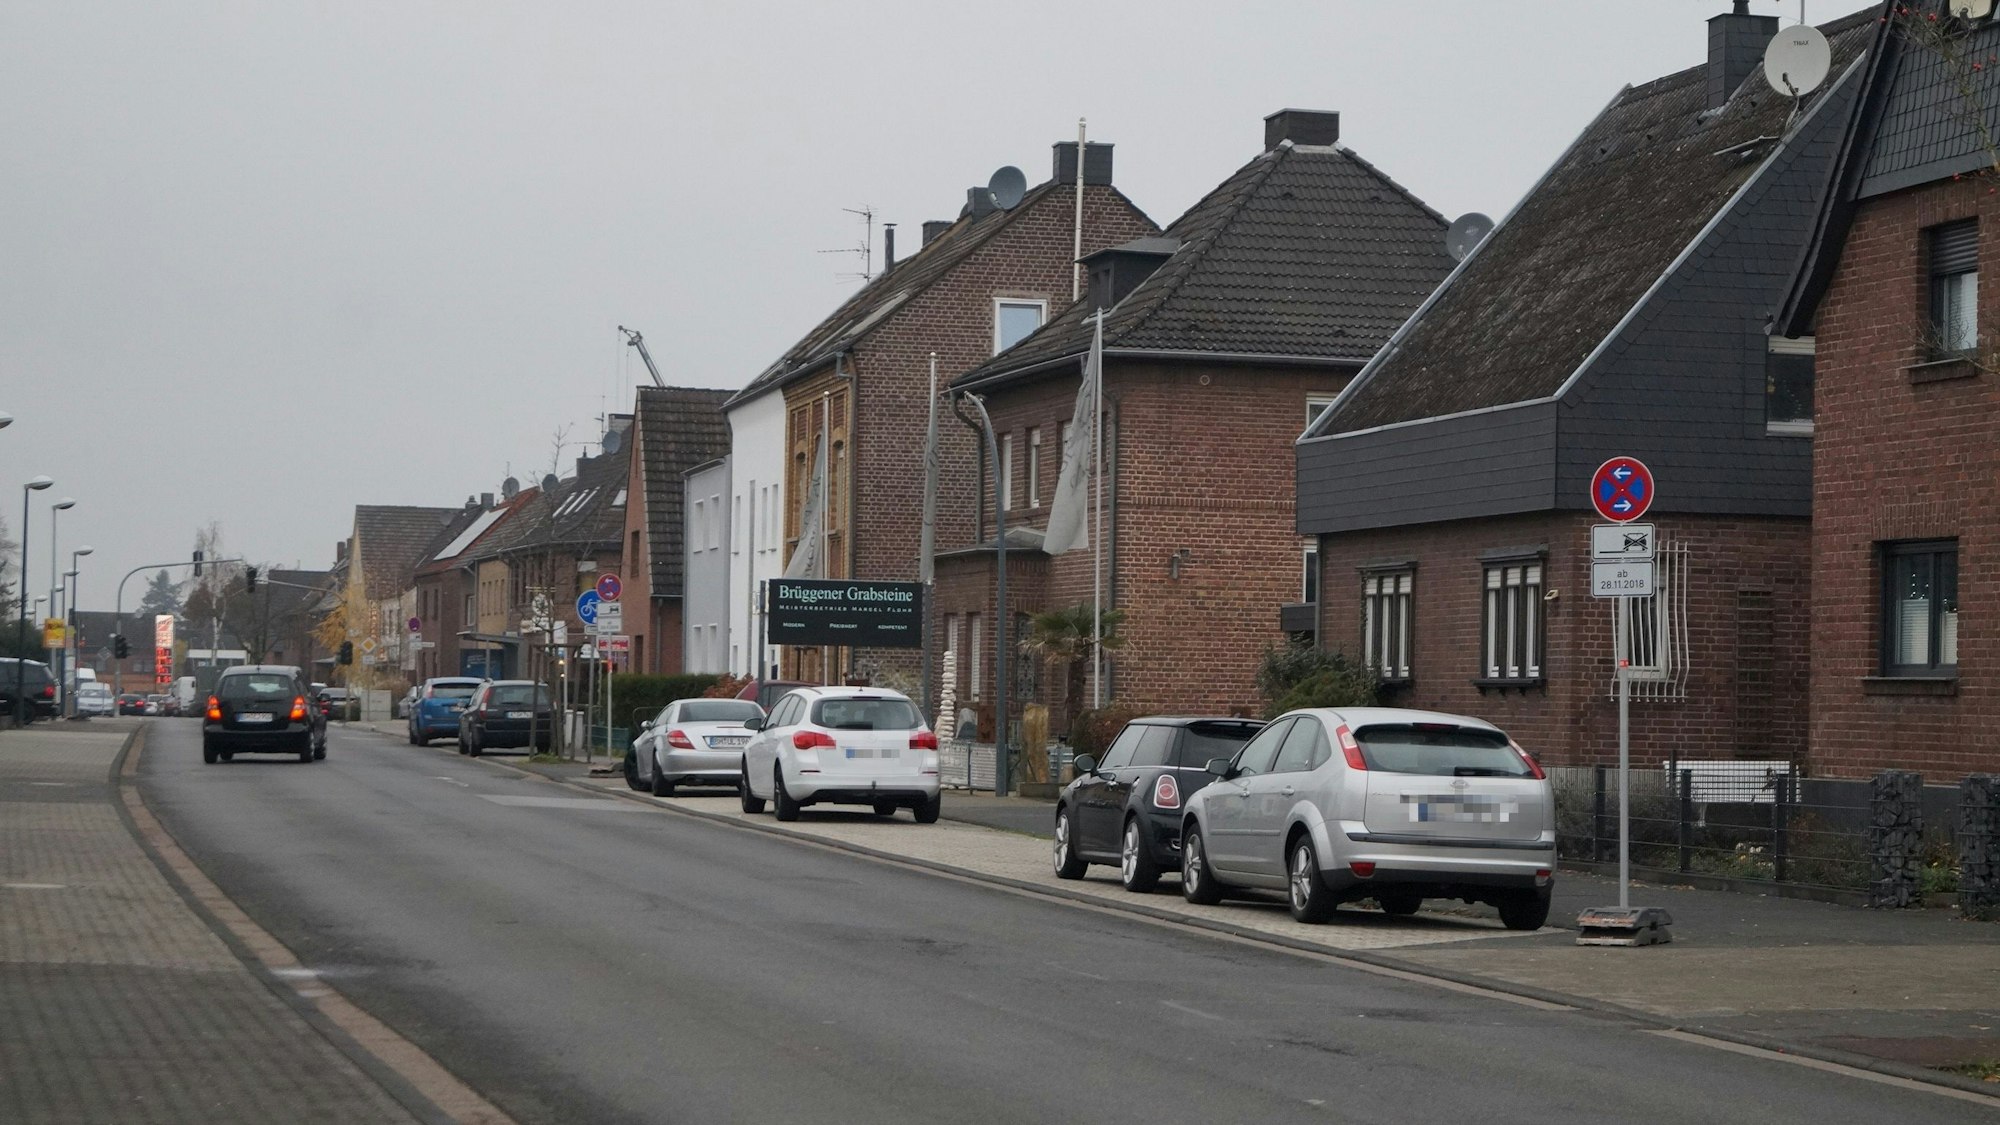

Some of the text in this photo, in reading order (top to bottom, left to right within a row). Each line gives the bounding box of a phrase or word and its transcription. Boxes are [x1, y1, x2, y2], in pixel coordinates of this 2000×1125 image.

[1617, 569, 1628, 578] ab
[1601, 579, 1645, 589] 28.11.2018
[779, 585, 913, 602] Brüggener Grabsteine
